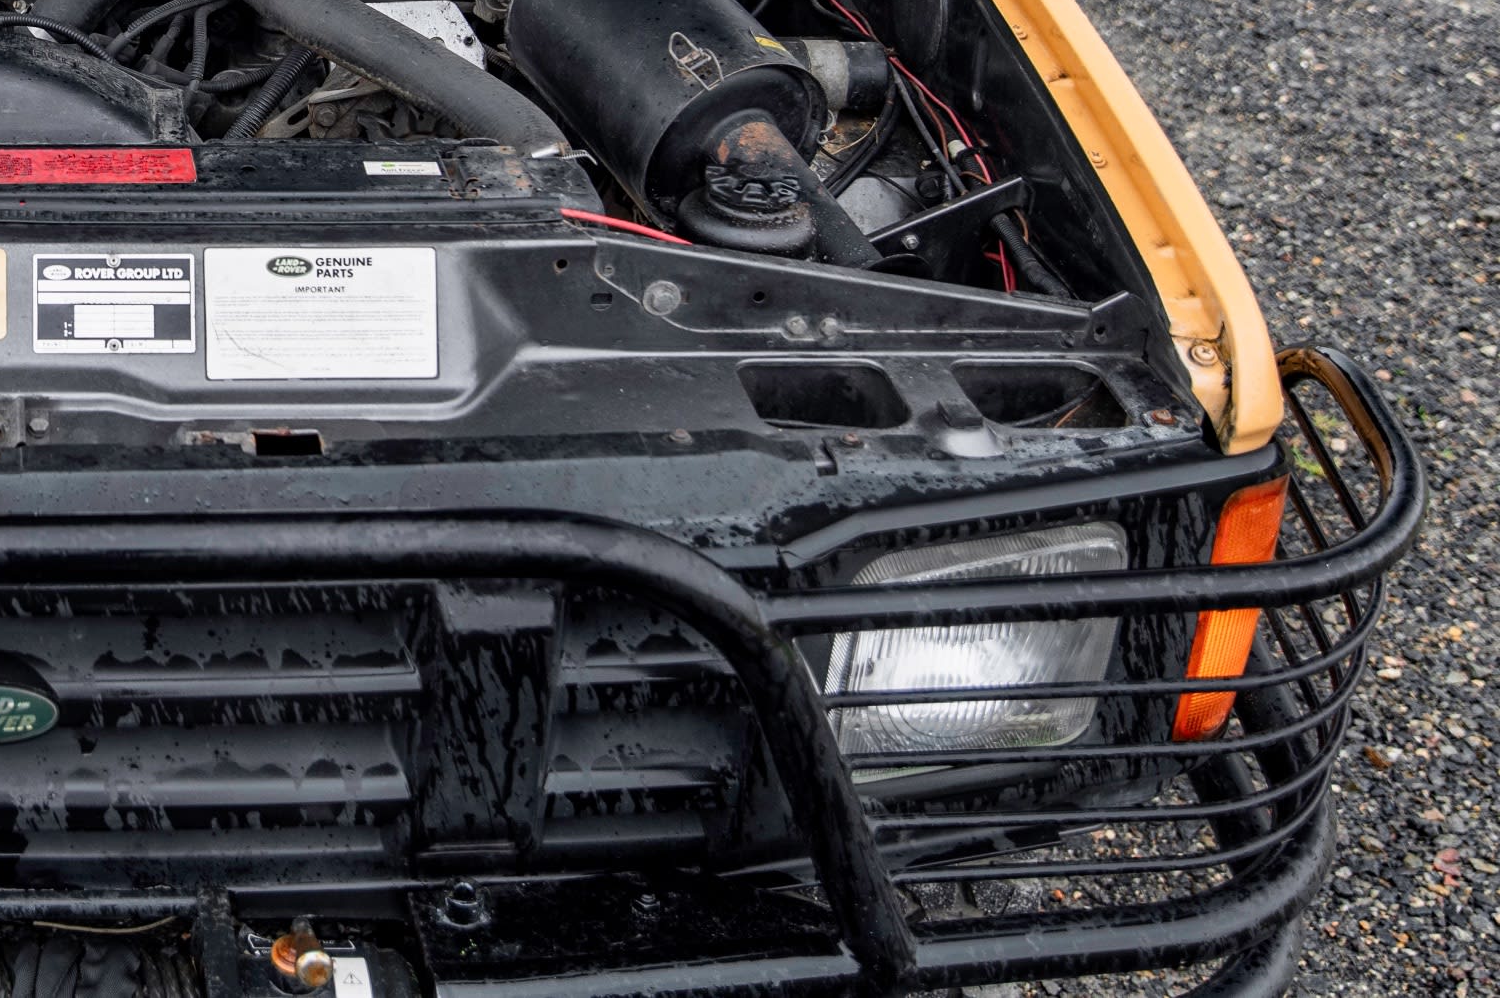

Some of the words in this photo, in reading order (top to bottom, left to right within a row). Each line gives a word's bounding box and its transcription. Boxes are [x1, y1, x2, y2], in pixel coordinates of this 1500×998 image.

[315, 257, 373, 266] GENUINE
[74, 267, 116, 279] ROVER
[116, 267, 160, 279] GROUP
[161, 267, 184, 279] LTD
[277, 266, 307, 274] ROVER
[316, 268, 354, 278] PARTS
